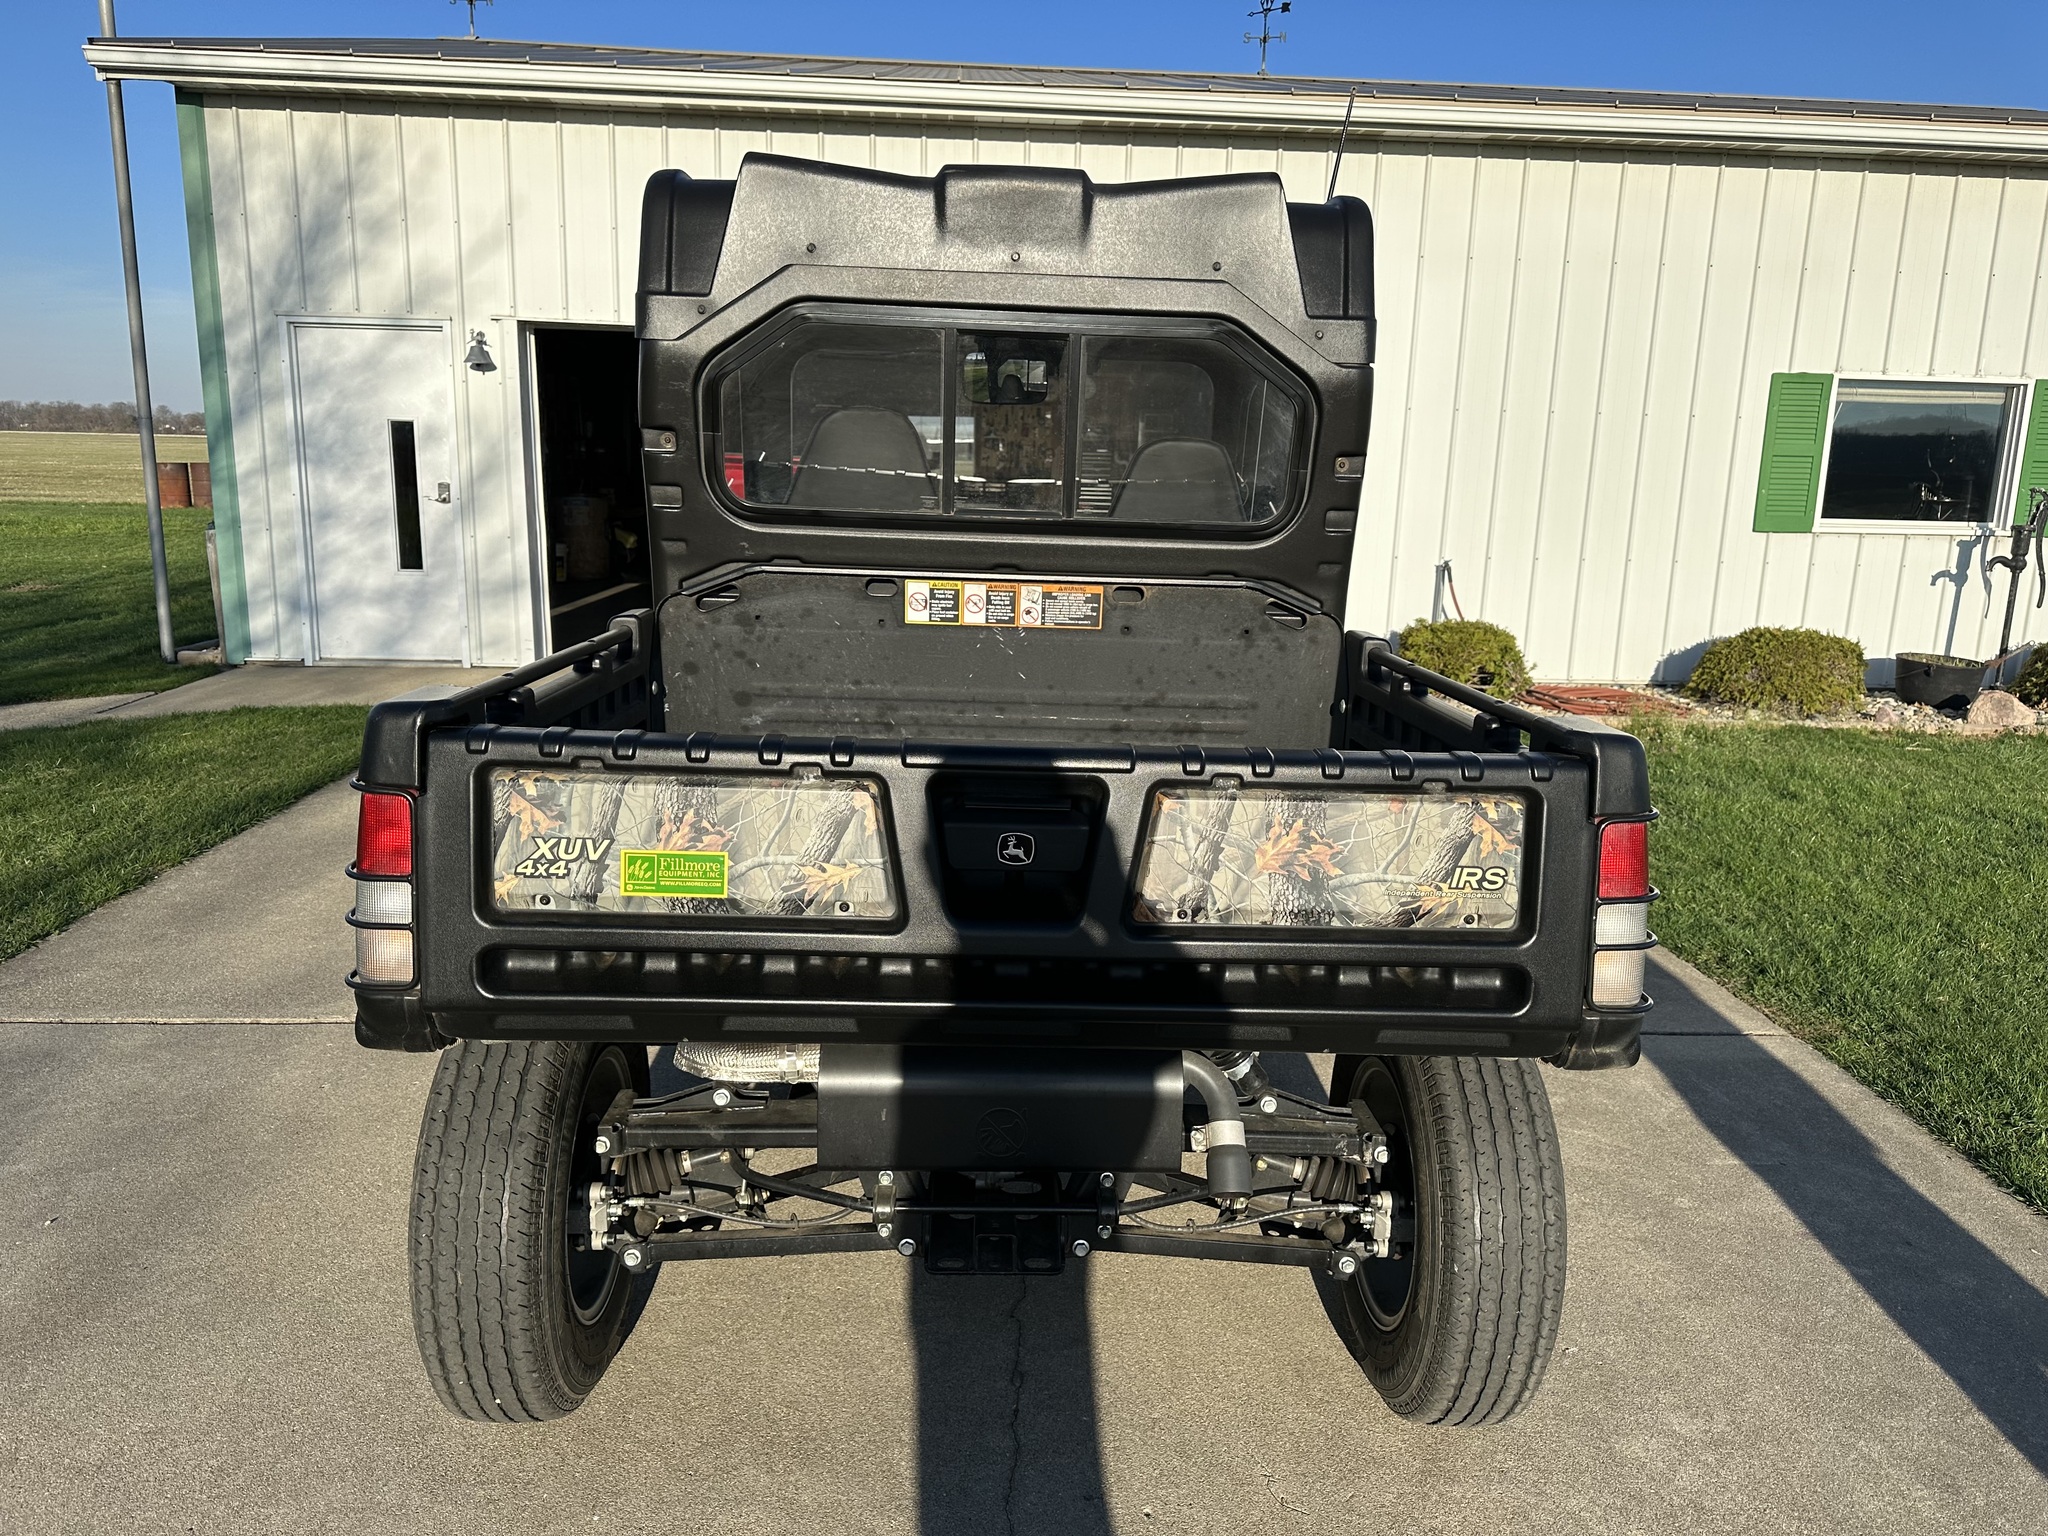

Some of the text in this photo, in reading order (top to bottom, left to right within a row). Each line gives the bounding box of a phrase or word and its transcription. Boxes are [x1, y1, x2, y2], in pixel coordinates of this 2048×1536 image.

[528, 836, 612, 861] XUV
[515, 859, 569, 877] 4x4
[659, 857, 721, 872] Fillmore
[658, 870, 705, 878] EQUIPMENT,
[1449, 866, 1508, 891] IRS
[659, 880, 722, 888] WWW.FILLMOREEQ.COM
[1384, 889, 1433, 897] Independent
[1456, 890, 1502, 899] Suspension
